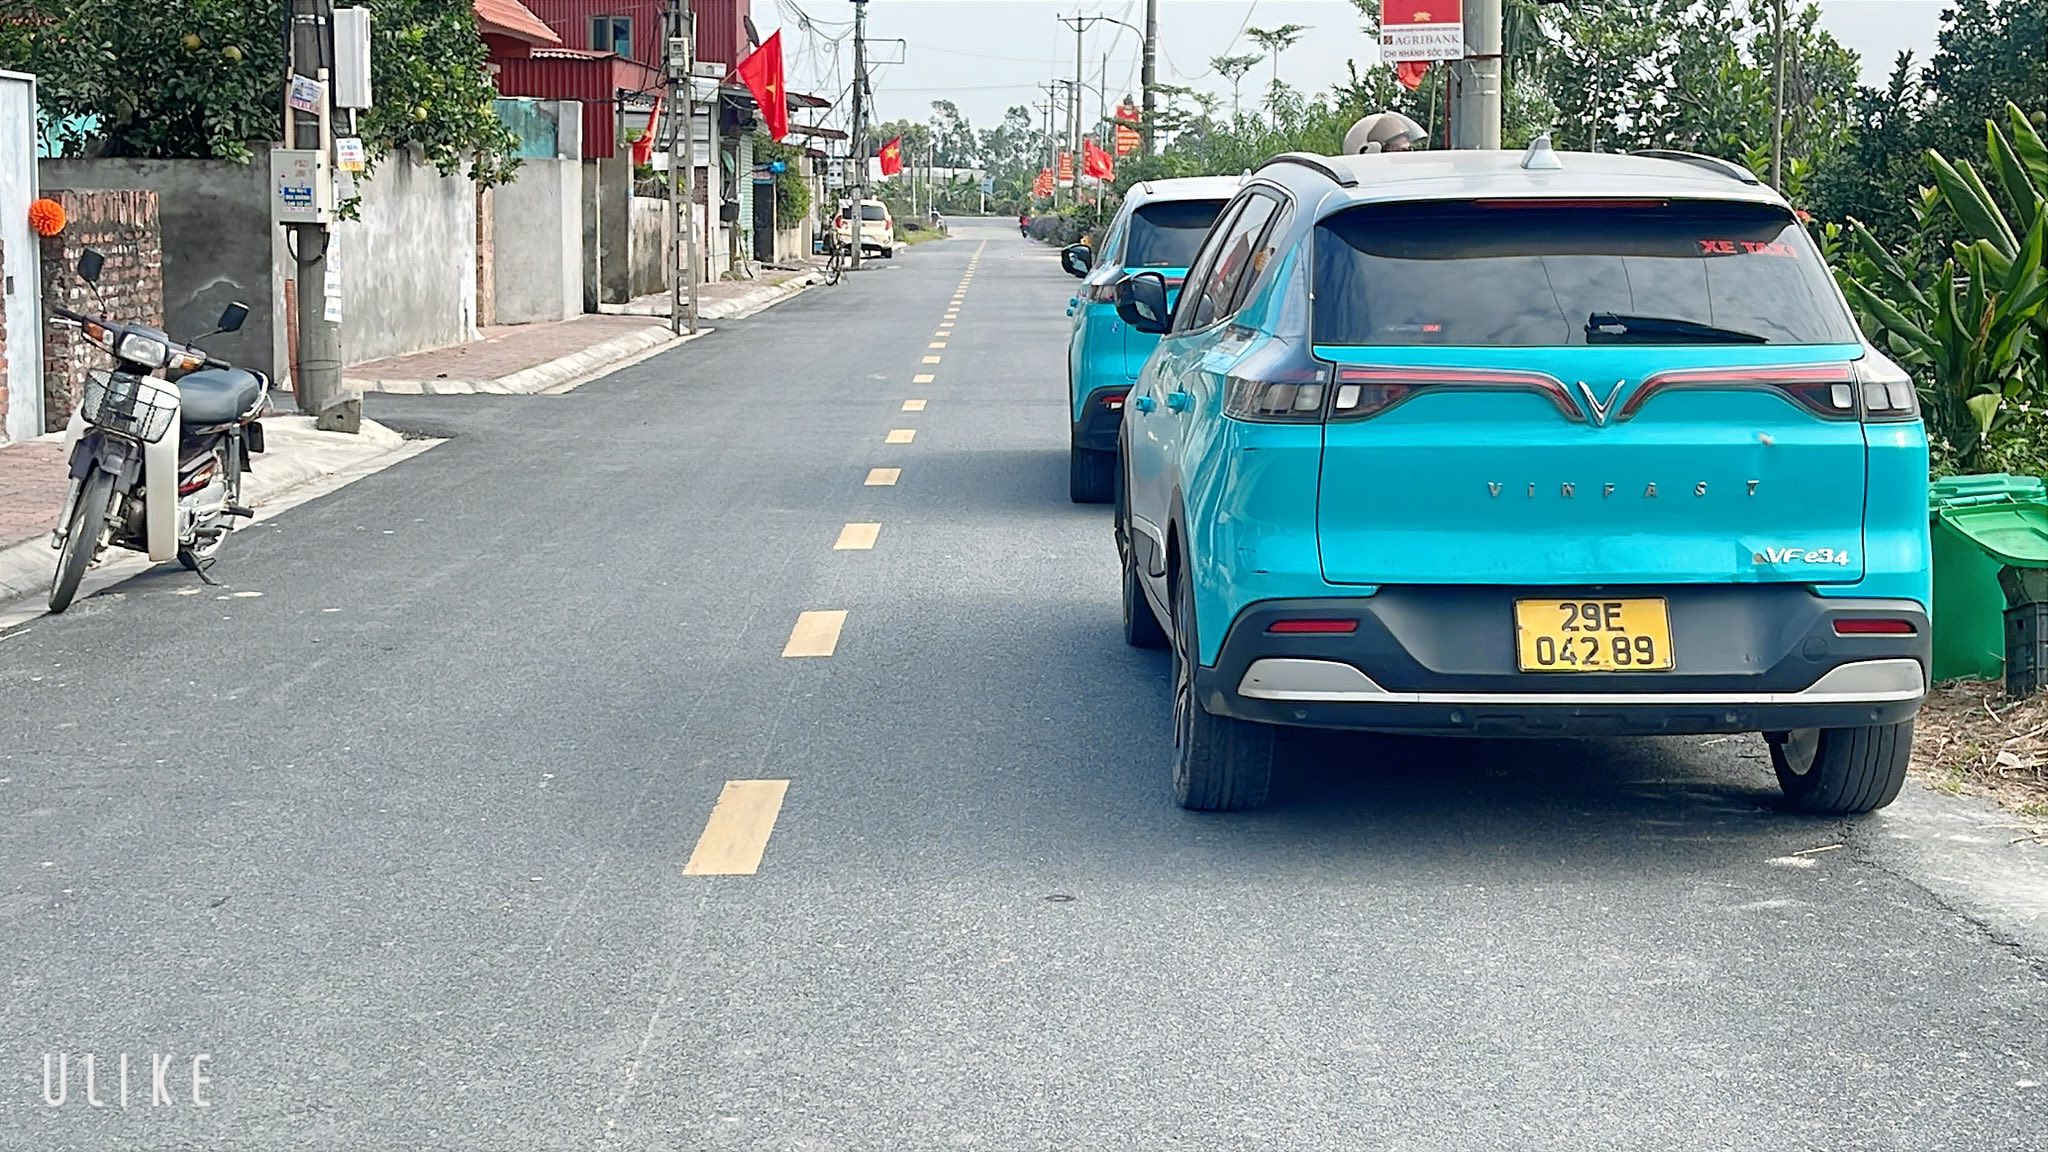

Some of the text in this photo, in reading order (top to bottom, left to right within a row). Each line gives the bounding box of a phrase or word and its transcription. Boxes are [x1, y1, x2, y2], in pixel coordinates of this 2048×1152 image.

[1395, 34, 1460, 45] AGRIBANK
[1399, 48, 1425, 57] NHÁNH
[1700, 240, 1798, 258] XE TAXI
[1766, 547, 1851, 566] VF e34
[1559, 603, 1625, 632] 29E
